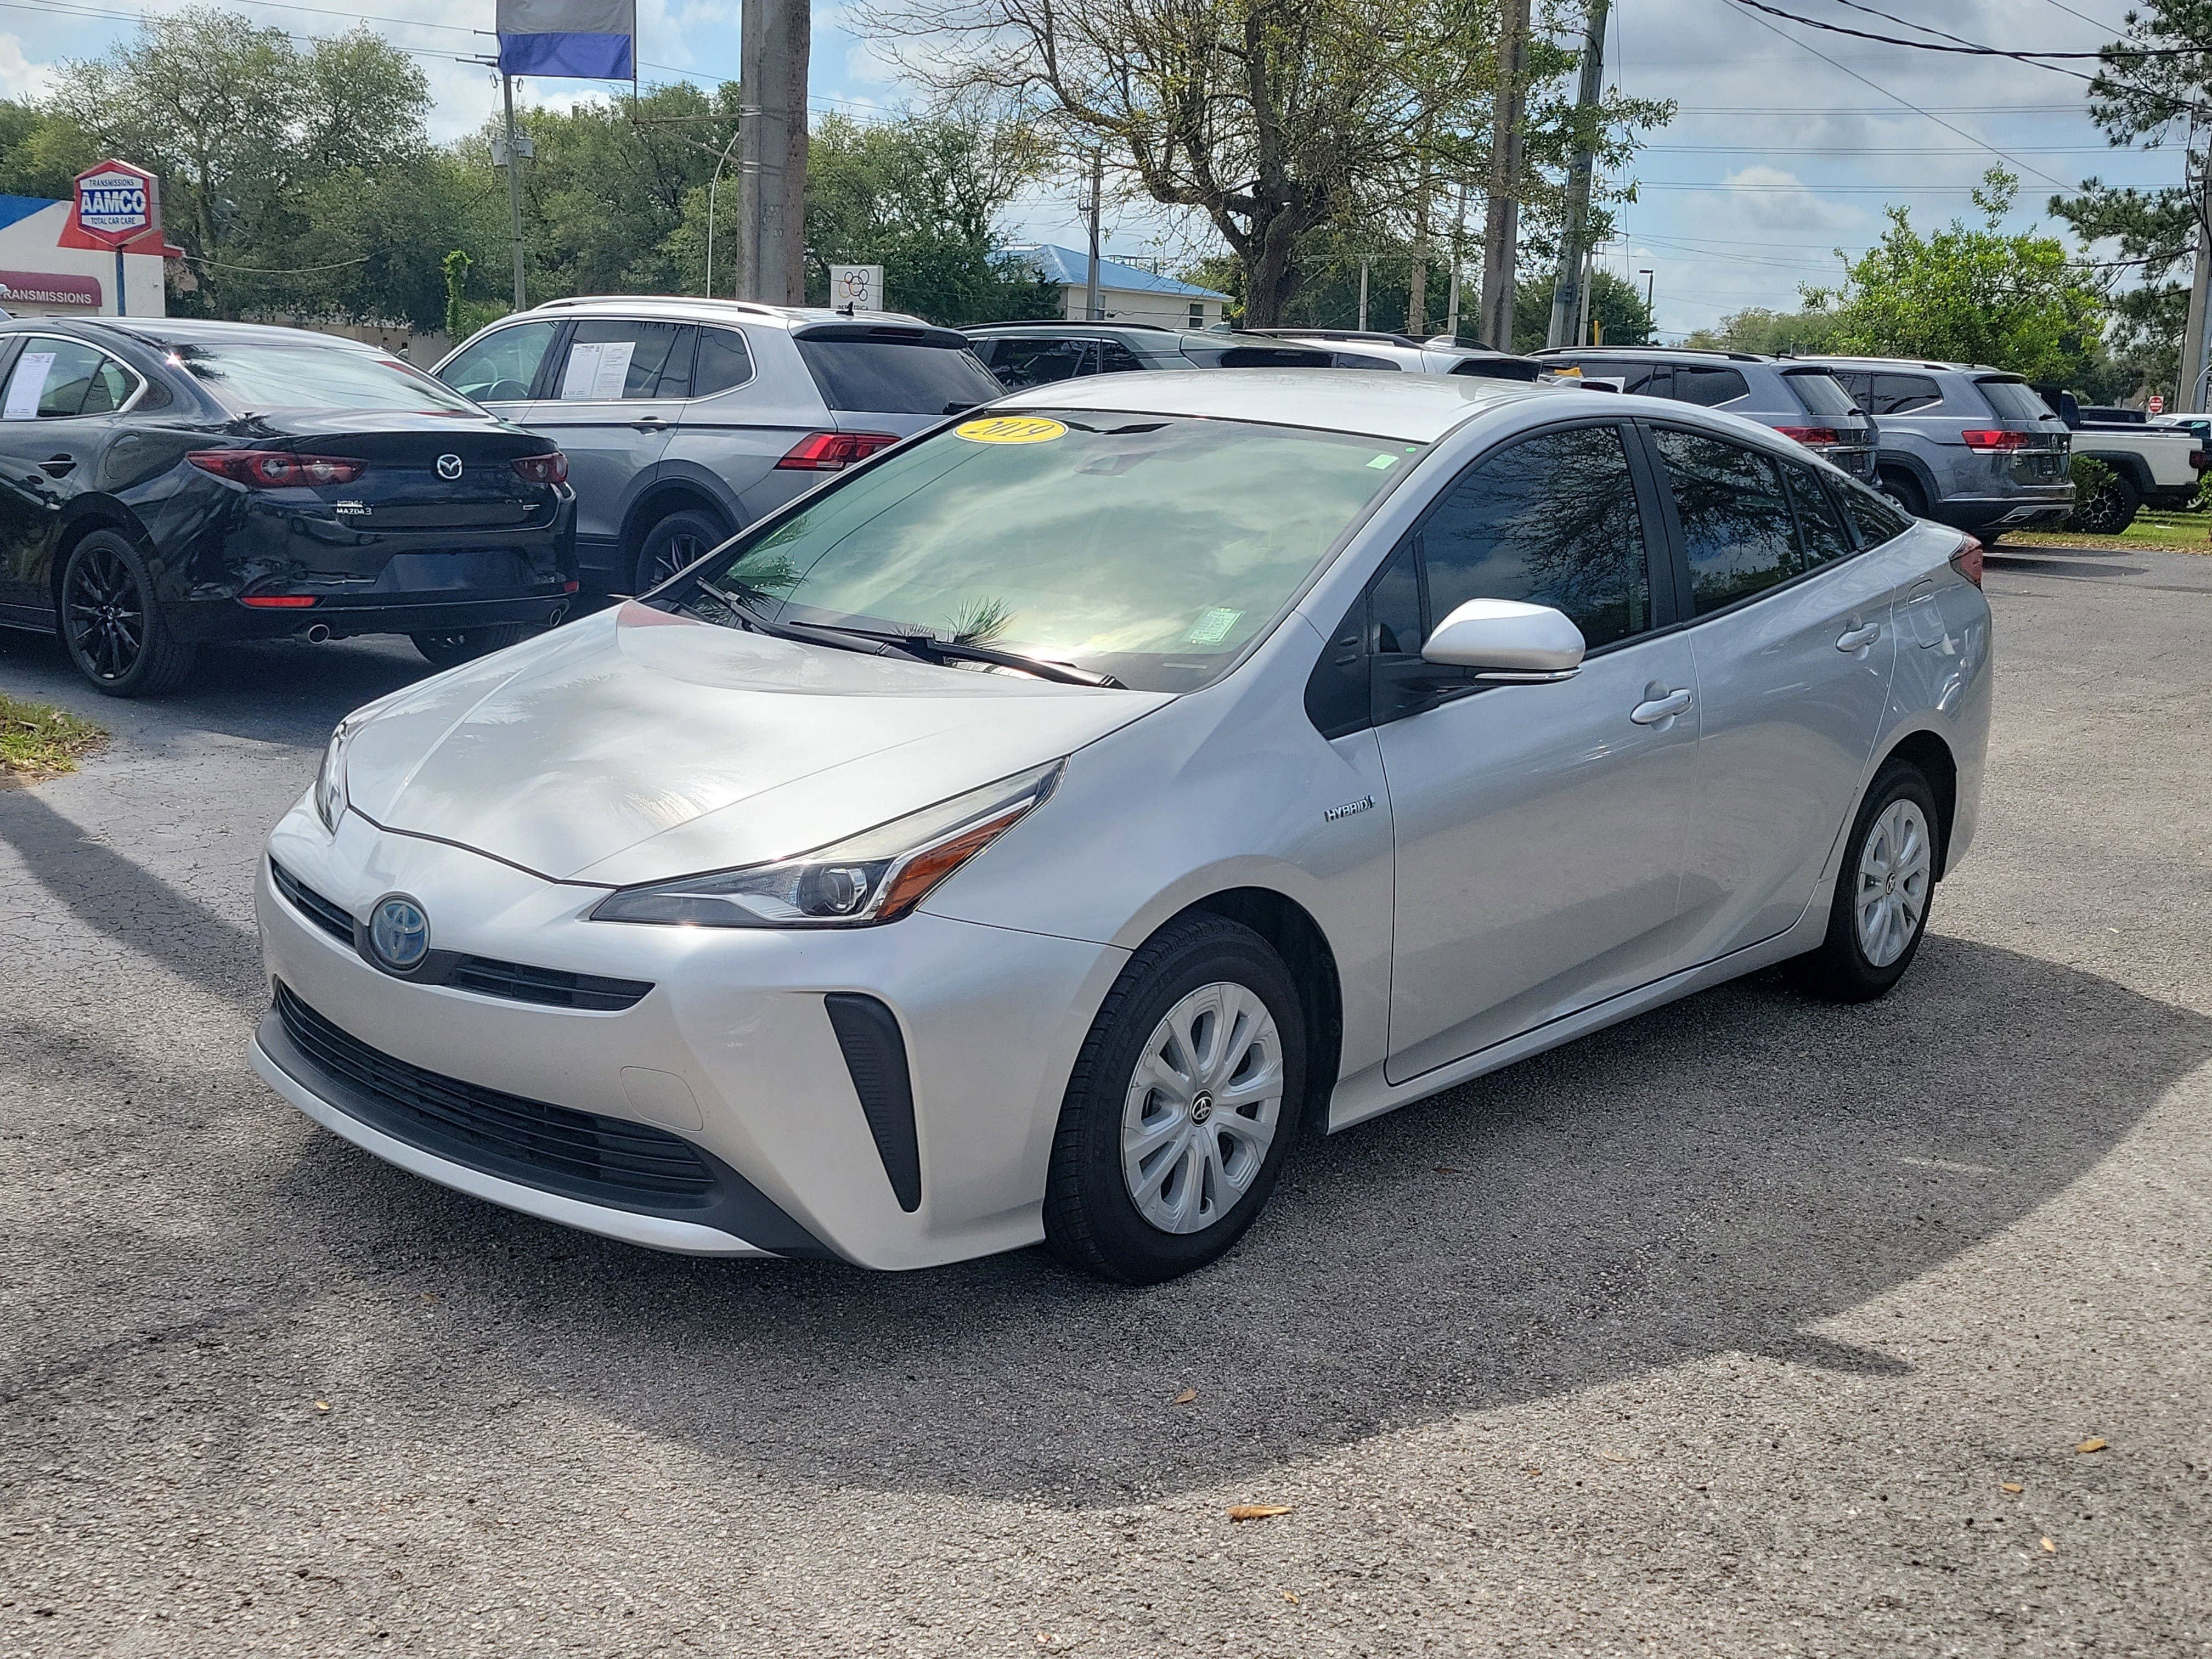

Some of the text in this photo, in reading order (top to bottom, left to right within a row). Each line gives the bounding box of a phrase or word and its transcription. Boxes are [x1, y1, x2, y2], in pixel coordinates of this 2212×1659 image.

[89, 179, 134, 187] TRANSMISSIONS
[80, 190, 146, 213] AAMCO
[0, 289, 92, 304] RANSMISSIONS
[963, 421, 1056, 438] 2019
[1324, 797, 1370, 822] HYBRID
